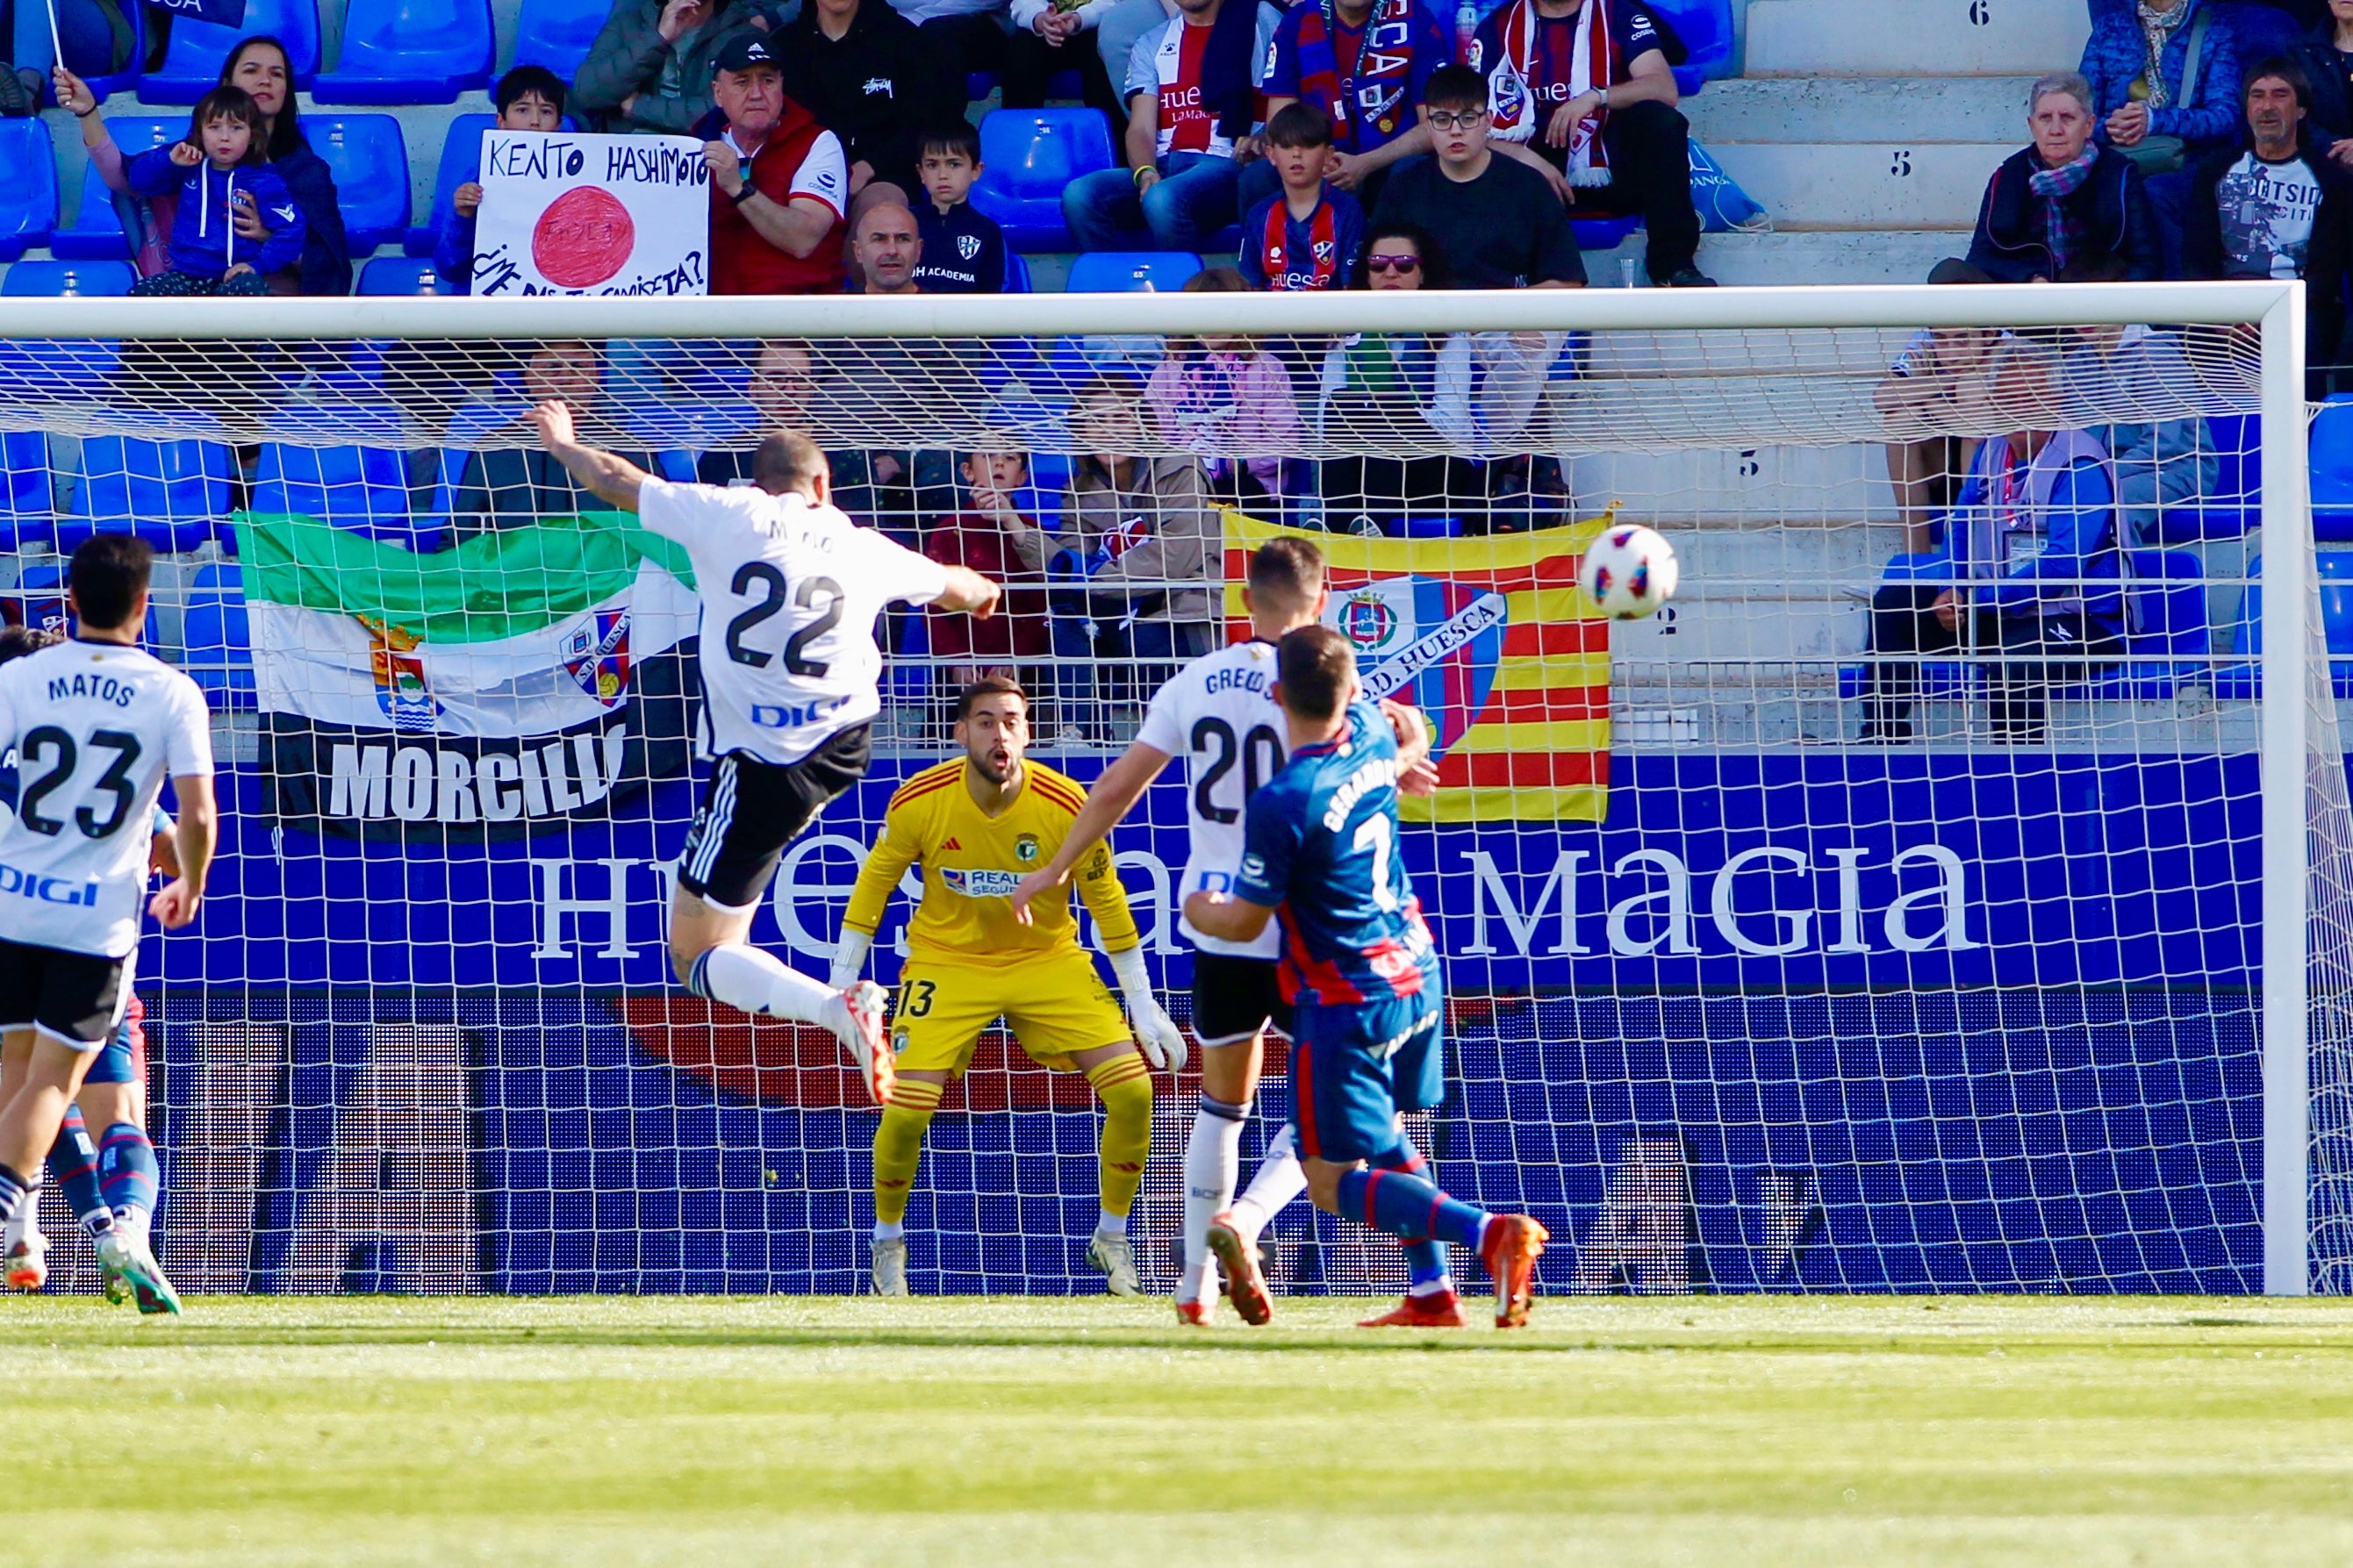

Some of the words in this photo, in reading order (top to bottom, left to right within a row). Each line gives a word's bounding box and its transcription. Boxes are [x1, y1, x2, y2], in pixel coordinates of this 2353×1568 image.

[1969, 1, 1990, 25] 6
[490, 138, 584, 179] KENTO
[1890, 151, 1911, 176] 5
[928, 268, 975, 283] ACADEMIA
[726, 561, 845, 677] 22
[1657, 607, 1677, 635] 2
[1397, 605, 1496, 676] HUESCA
[48, 674, 135, 707] MATOS
[21, 725, 143, 839] 23
[1190, 716, 1288, 825] 20
[972, 871, 1021, 884] REAL
[899, 979, 936, 1018] 13
